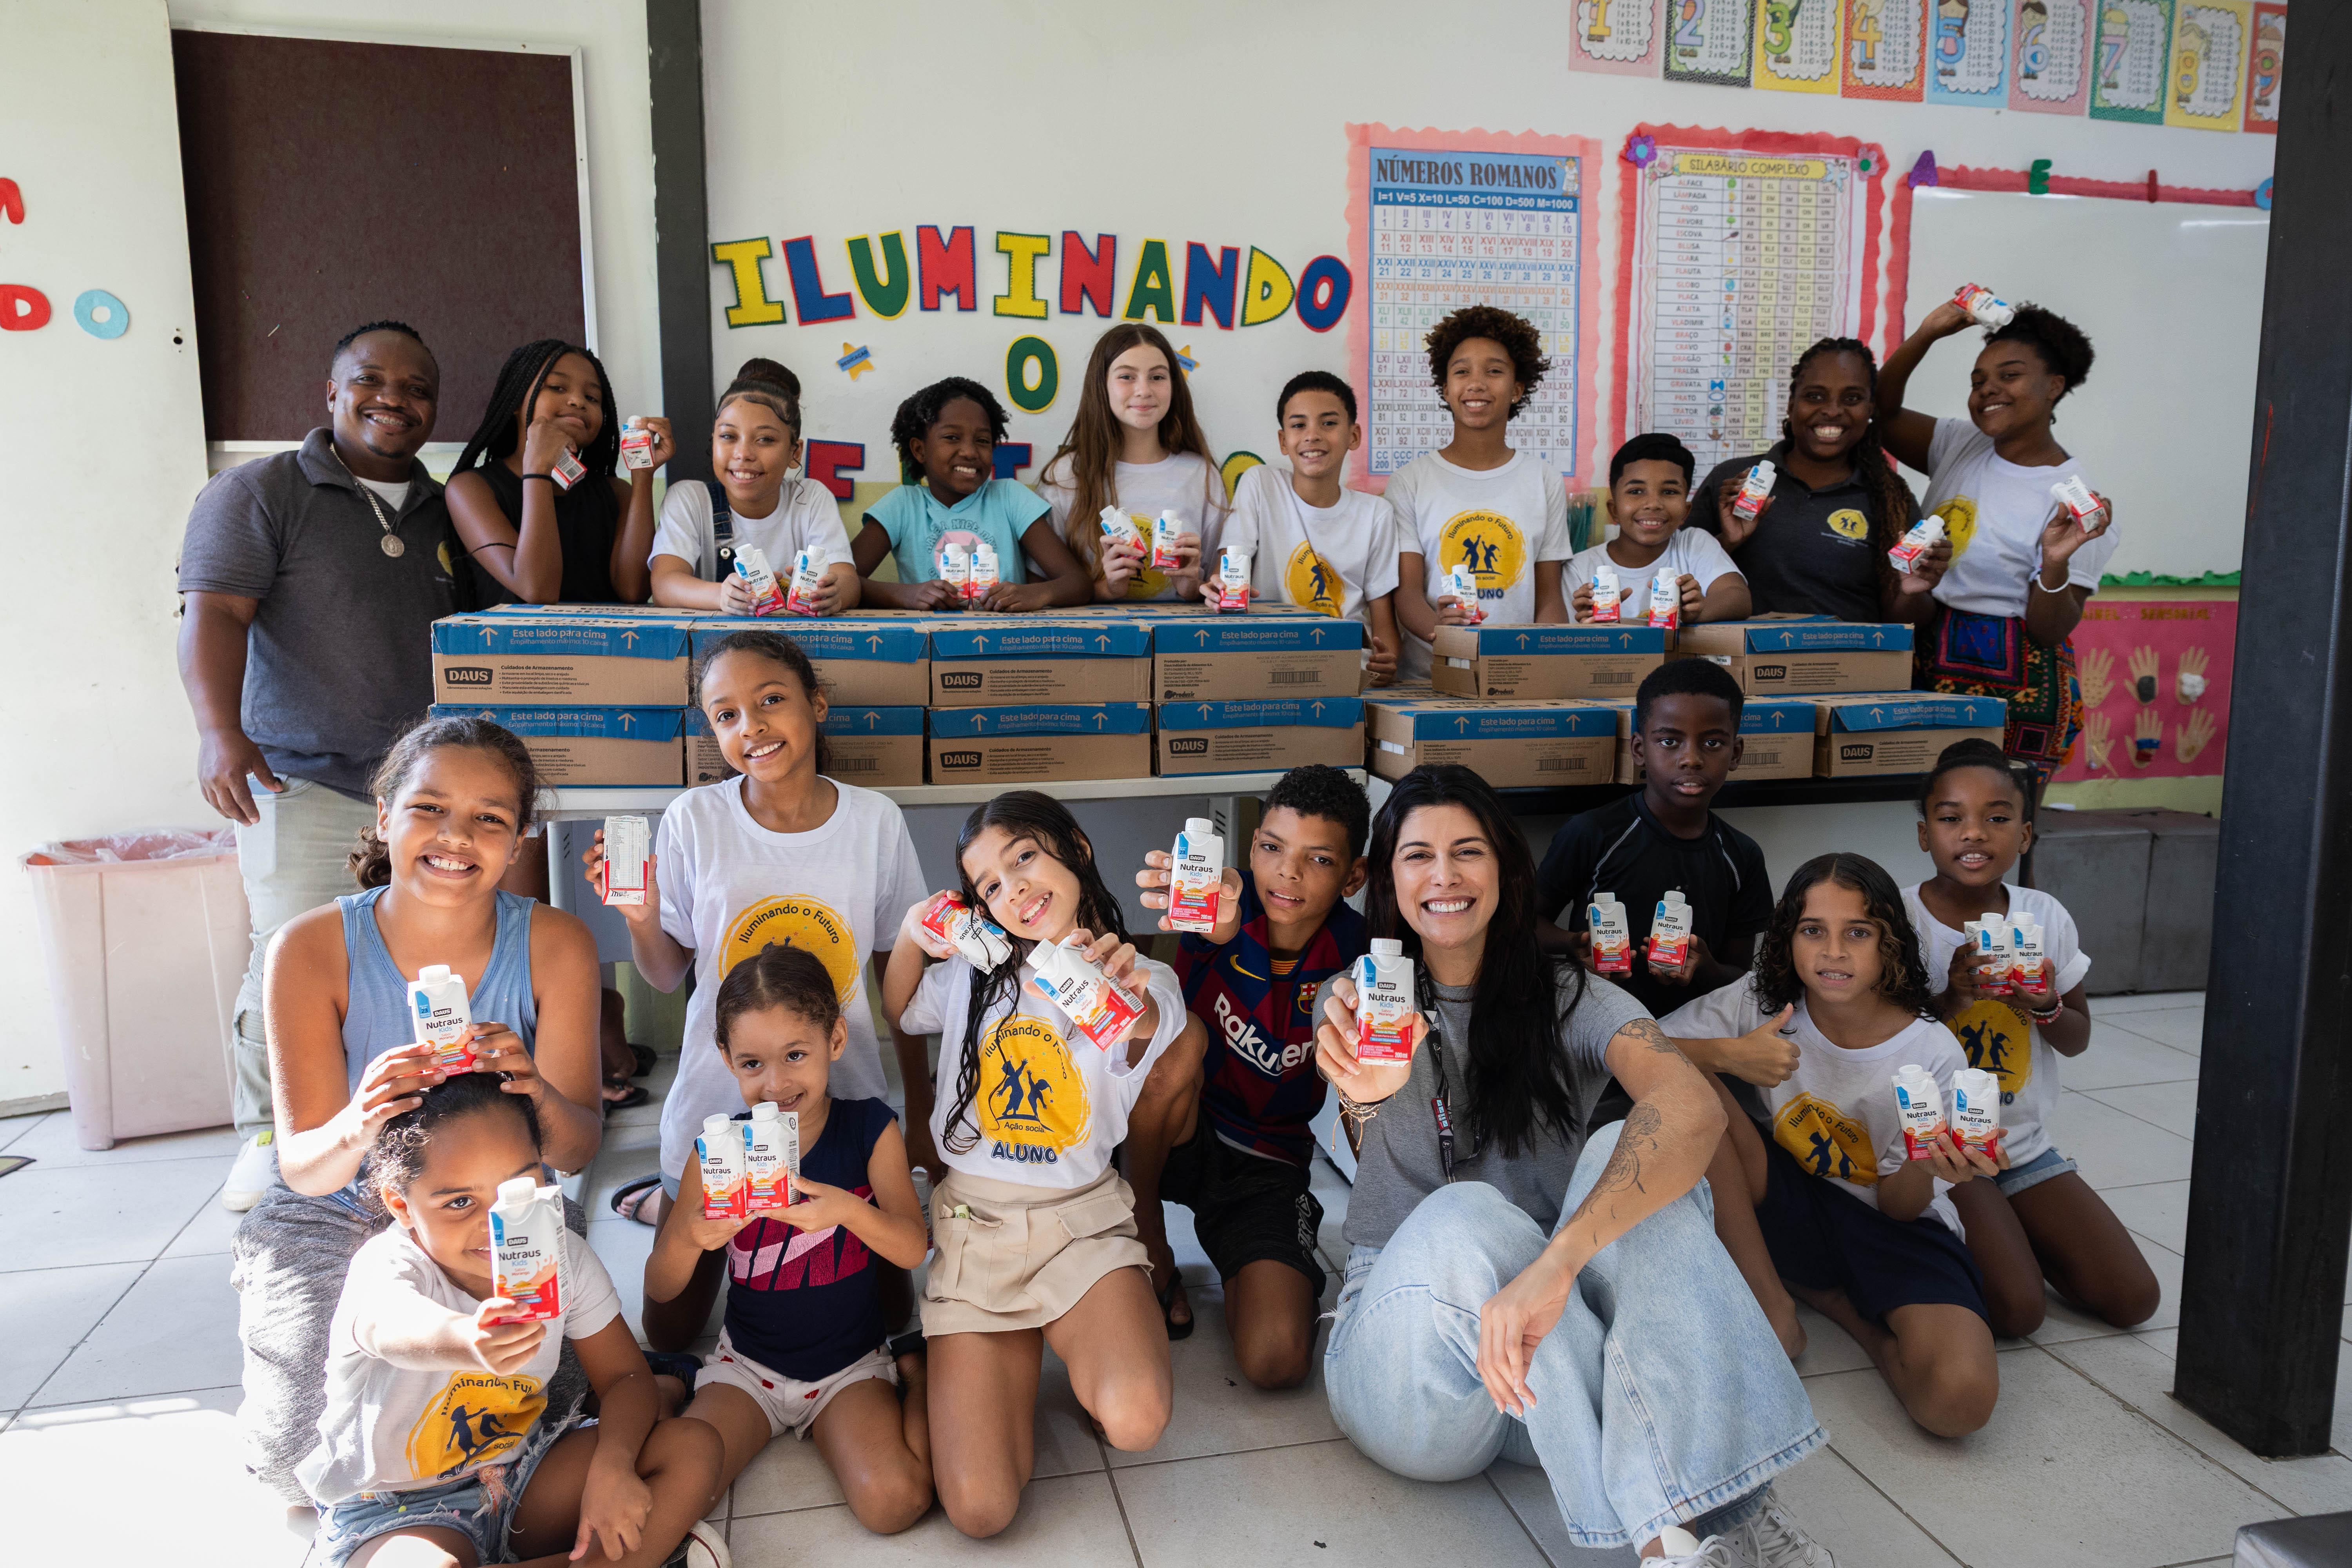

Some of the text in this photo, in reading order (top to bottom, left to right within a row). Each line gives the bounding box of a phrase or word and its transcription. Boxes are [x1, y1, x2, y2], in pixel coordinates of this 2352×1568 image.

[1673, 0, 1704, 46] 2
[1764, 2, 1791, 54] 3
[1852, 2, 1882, 59] 4
[1937, 17, 1965, 64] 5
[2023, 24, 2049, 71] 6
[2101, 34, 2129, 78] 7
[2176, 49, 2199, 94] 8
[2256, 49, 2281, 96] 9
[1377, 154, 1557, 189] NÚMEROS ROMANOS
[1690, 159, 1809, 175] SILABÁRIO COMPLEXO
[1909, 150, 2158, 203] A E I
[1378, 192, 1573, 209] I=1 V=5 X=10 L=50 C=100 D=500 M=1000
[1383, 209, 1570, 224] I II III IV V VI VII VIII IX X
[1403, 219, 1408, 227] 2
[1424, 220, 1430, 228] 3
[1444, 220, 1450, 229] 4
[1466, 221, 1471, 229] 5
[1486, 222, 1492, 230] 6
[1506, 222, 1511, 231] 7
[1525, 223, 1531, 232] 8
[1544, 224, 1550, 232] 9
[1563, 225, 1572, 233] 10
[710, 225, 1352, 333] ILUMINANDO
[1005, 334, 1058, 414] O
[951, 519, 979, 532] NICE
[1447, 515, 1485, 539] Iluminando
[1495, 518, 1513, 540] Futuro
[513, 629, 606, 641] Este lado para cima
[809, 635, 829, 645] para
[831, 634, 853, 644] cima
[1022, 635, 1041, 644] lado
[1042, 636, 1061, 646] para
[1062, 635, 1083, 643] cima
[1260, 632, 1278, 641] para
[1279, 630, 1299, 639] cima
[448, 670, 489, 682] DAUS
[1757, 668, 1784, 677] DAUS
[944, 675, 979, 686] DAUS
[534, 712, 555, 720] lado
[557, 713, 579, 724] para
[581, 713, 604, 721] cima
[1020, 713, 1038, 722] lado
[1040, 714, 1059, 724] para
[1060, 713, 1081, 721] cima
[1517, 719, 1535, 728] para
[1172, 740, 1205, 751] DAUS
[1844, 747, 1871, 757] DAUS
[944, 754, 978, 766] DAUS
[1180, 864, 1213, 873] Nutraus
[739, 903, 799, 944] Iluminando
[813, 910, 839, 944] Futuro
[1060, 978, 1073, 993] DAUS
[1062, 980, 1089, 1008] Nutraus
[1074, 993, 1086, 1005] Kids
[1368, 993, 1406, 1003] Nutraus
[426, 1017, 463, 1030] Nutraus
[1044, 1031, 1052, 1041] o
[1907, 1110, 1937, 1119] Nutraus
[1960, 1115, 1992, 1123] Nutraus
[1004, 1122, 1024, 1131] Ação
[1835, 1121, 1858, 1143] Futuro
[991, 1140, 1058, 1165] ALUNO
[508, 1238, 528, 1246] DAUS
[499, 1250, 541, 1261] Nutraus
[494, 1439, 515, 1450] social
